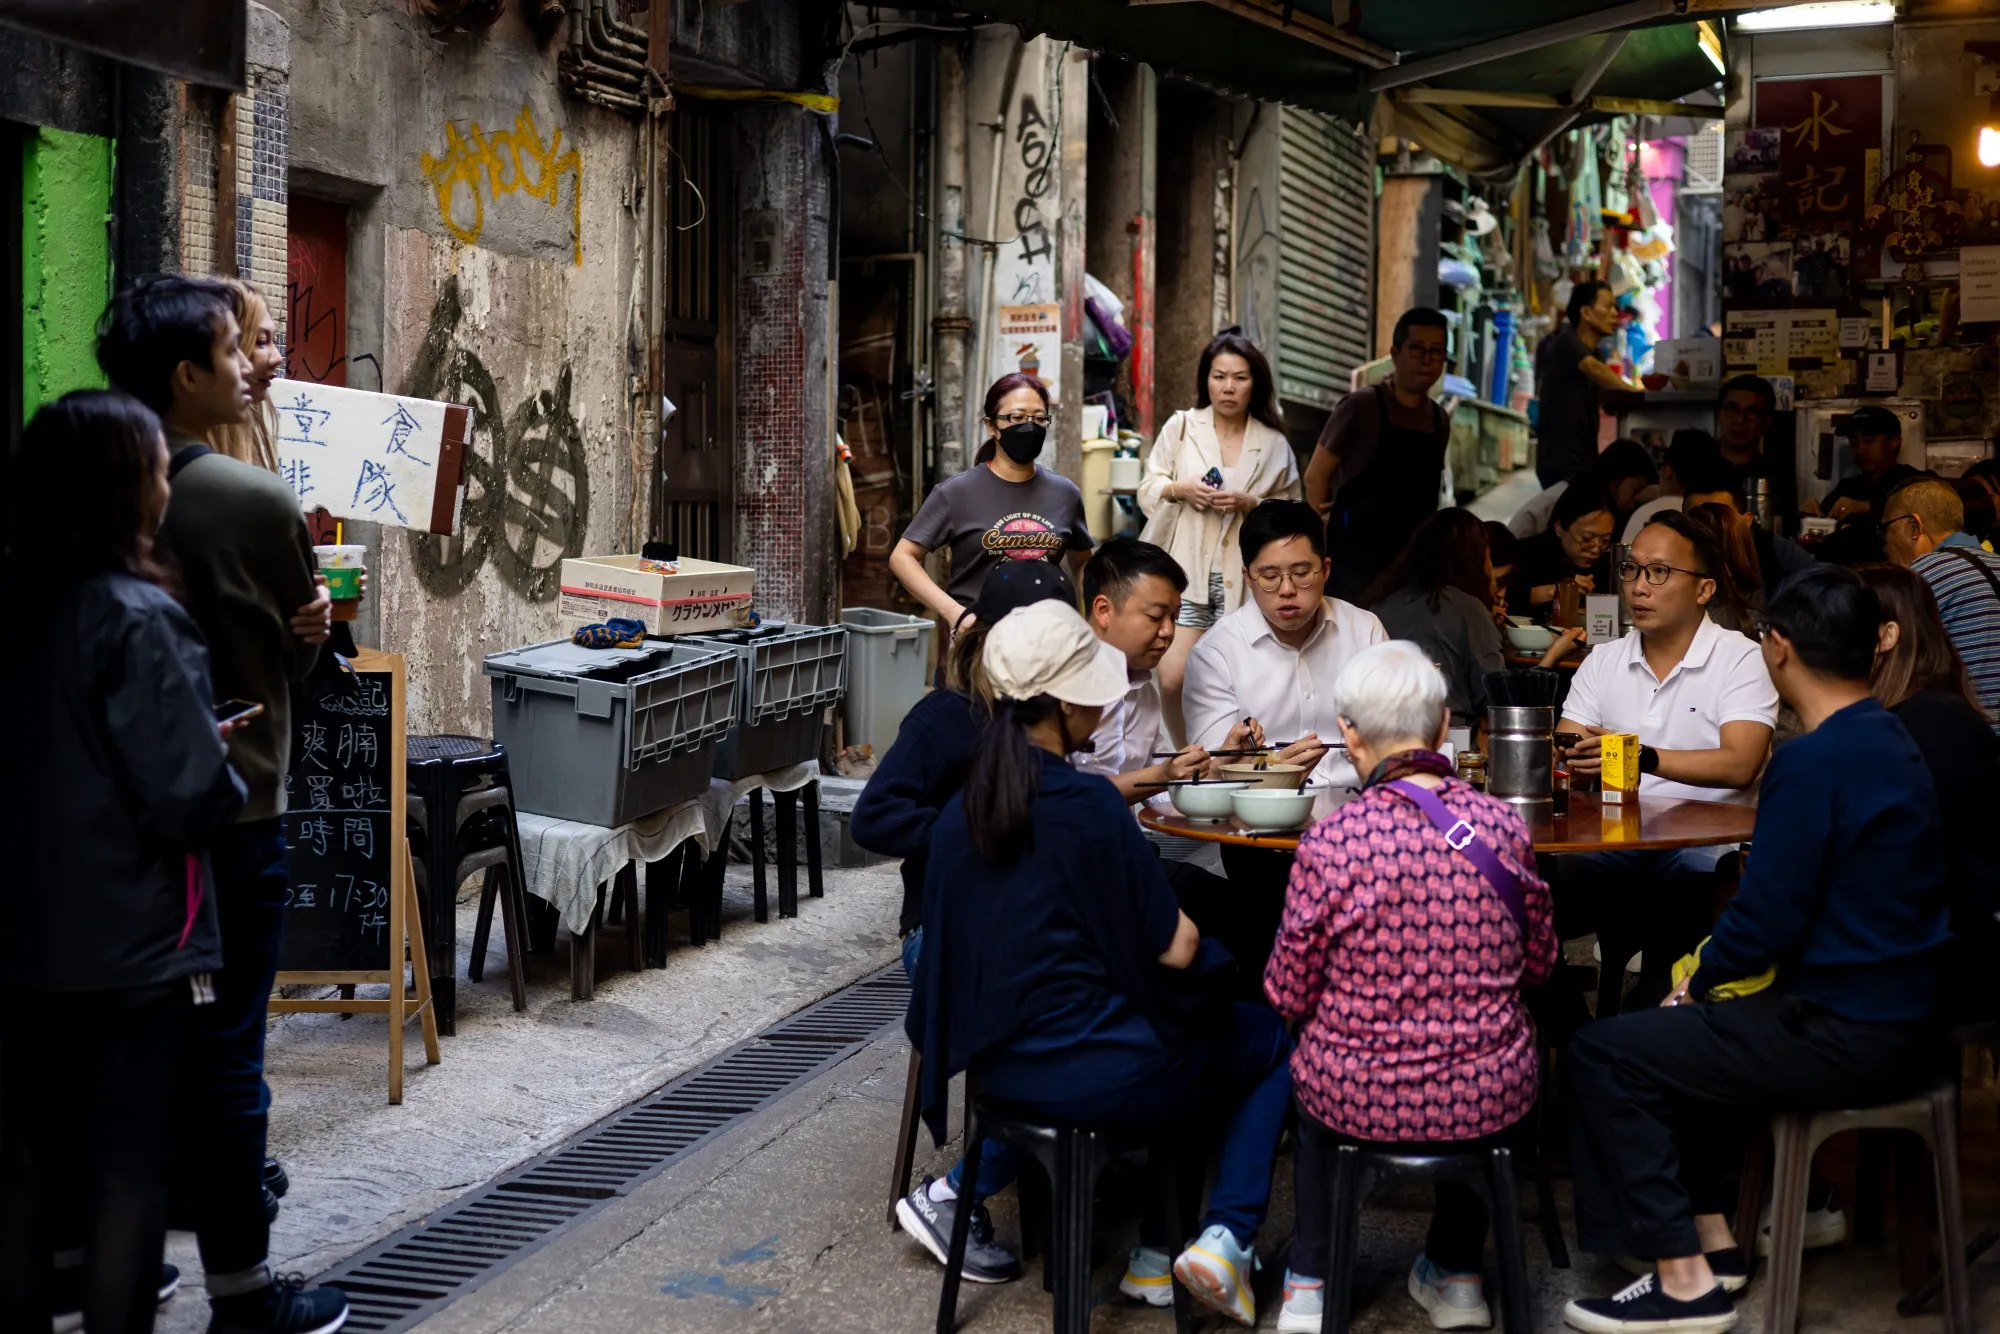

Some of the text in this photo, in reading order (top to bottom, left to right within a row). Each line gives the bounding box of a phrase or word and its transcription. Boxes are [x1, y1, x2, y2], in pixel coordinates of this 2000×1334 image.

[1783, 90, 1854, 215] 水記
[1003, 512, 1022, 522] LIGHT
[982, 529, 1062, 549] Camellia
[671, 600, 736, 622] クラウンメロ
[284, 773, 387, 811] 買啦
[282, 815, 375, 860] 時間
[329, 873, 388, 913] 17:30
[912, 1187, 938, 1225] HOKA
